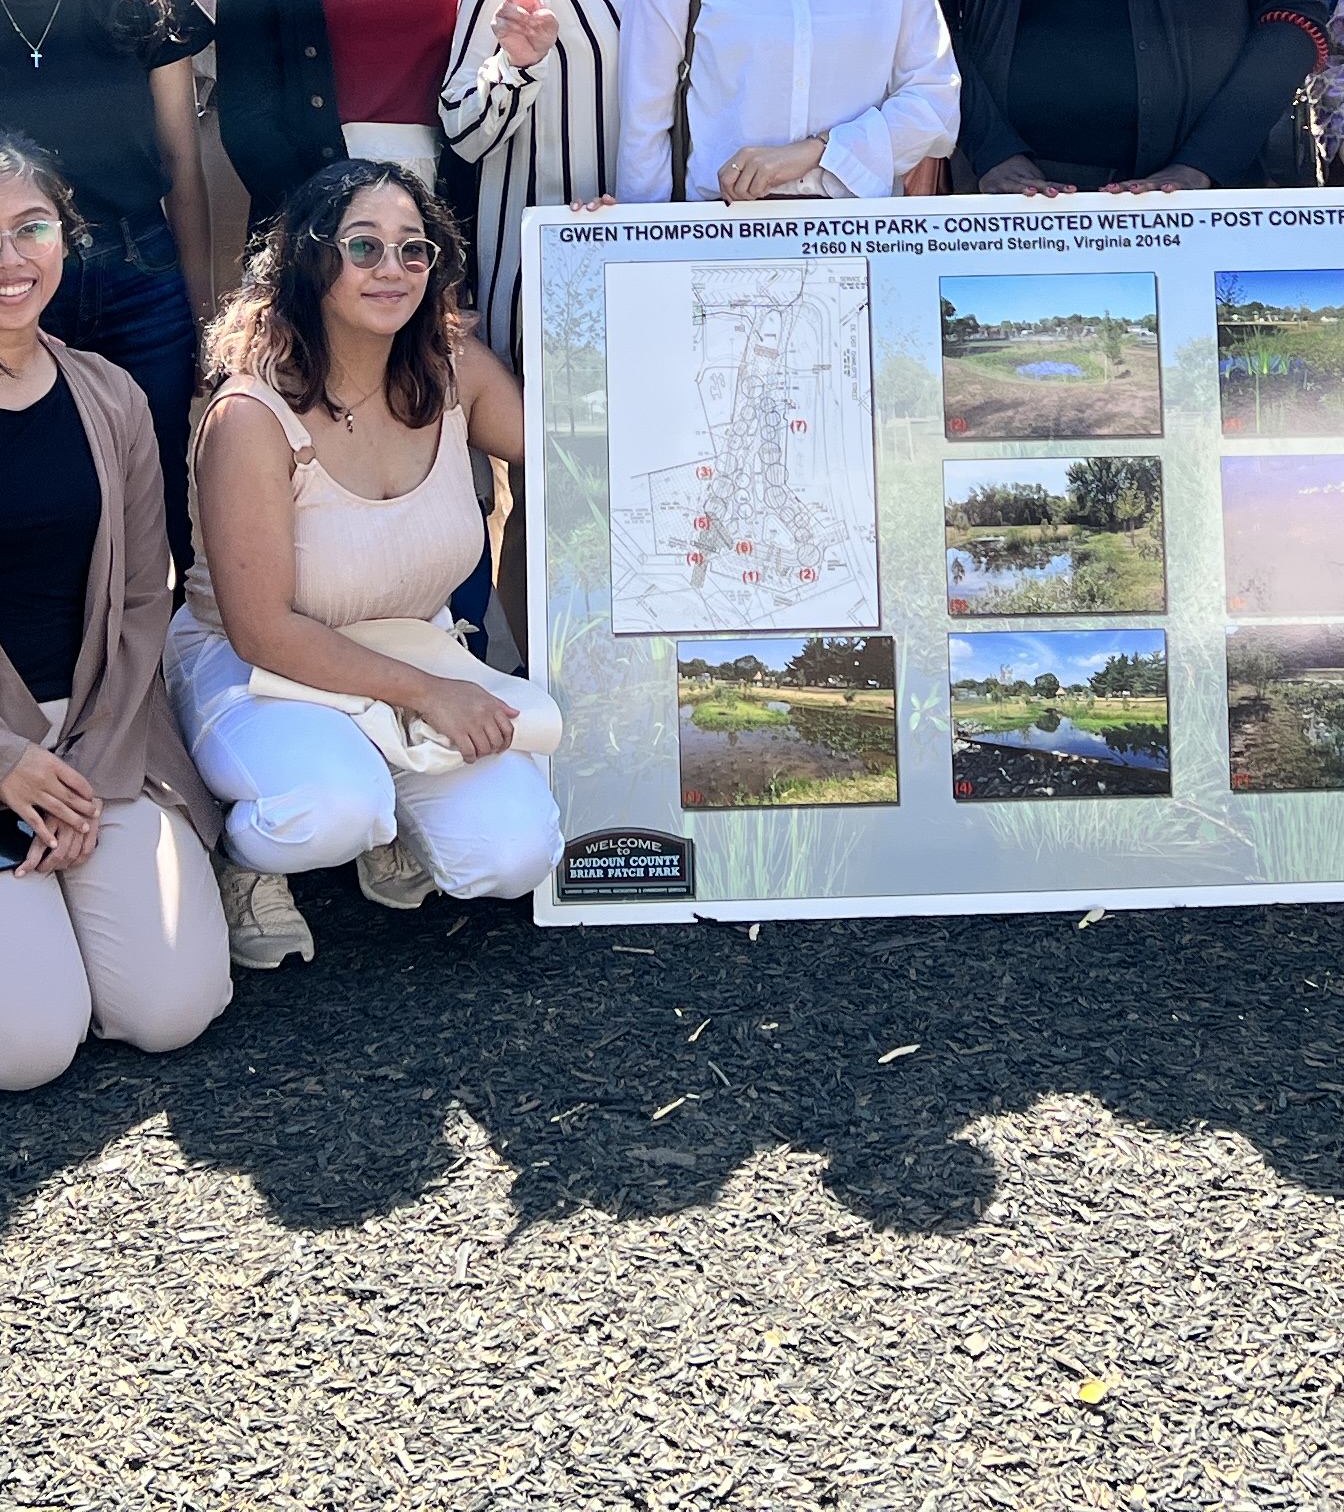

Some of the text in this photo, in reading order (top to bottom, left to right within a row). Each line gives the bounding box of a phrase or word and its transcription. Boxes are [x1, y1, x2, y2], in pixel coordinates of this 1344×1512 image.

[559, 226, 618, 242] GWEN
[623, 223, 733, 241] THOMPSON
[739, 221, 799, 238] BRIAR
[804, 220, 869, 236] PATCH
[875, 218, 928, 235] PARK
[944, 215, 1092, 233] CONSTRUCTED
[1099, 212, 1194, 230] WETLAND
[1211, 210, 1263, 227] POST
[801, 233, 1181, 256] 21660 N Sterling Boulevard Sterling, Virginia 20164
[790, 419, 807, 434] (7)
[695, 466, 713, 480] (3)
[693, 517, 711, 530] (5)
[736, 541, 753, 555] (6)
[686, 552, 704, 565] (4)
[742, 570, 760, 584] (1)
[799, 568, 817, 582] (2)
[955, 780, 973, 796] (4)
[585, 837, 662, 854] WELCOME
[616, 847, 631, 856] to
[569, 854, 680, 868] LOUDOUN COUNTY
[569, 866, 680, 879] BRIAR PATCH PARK
